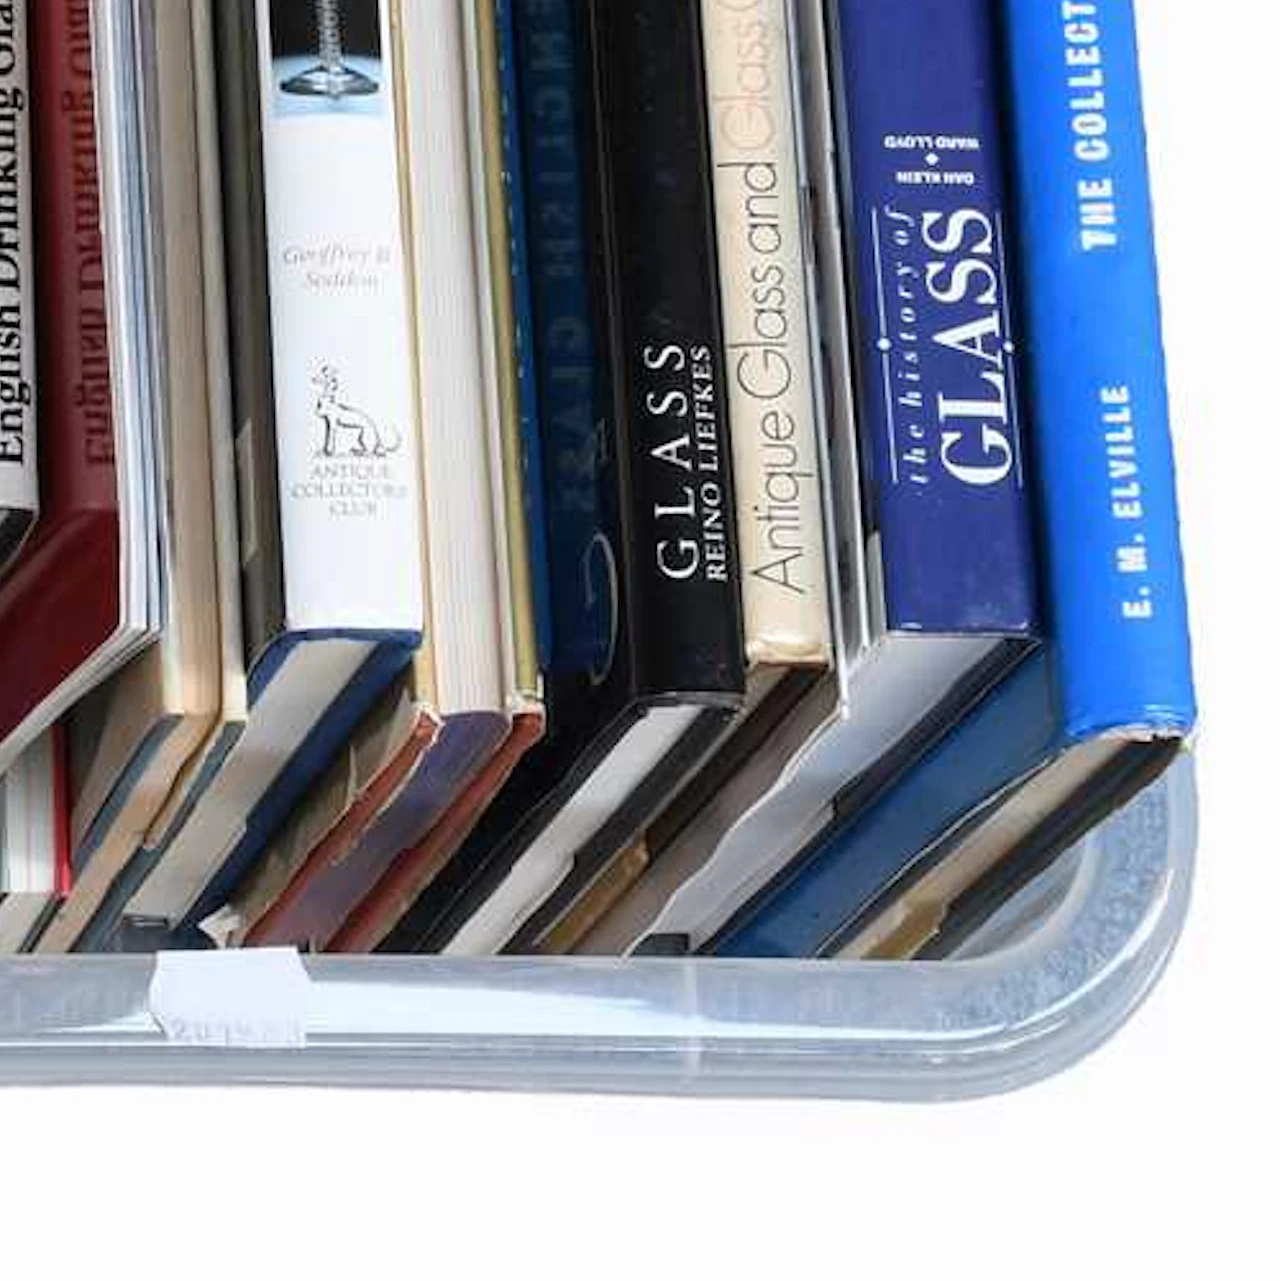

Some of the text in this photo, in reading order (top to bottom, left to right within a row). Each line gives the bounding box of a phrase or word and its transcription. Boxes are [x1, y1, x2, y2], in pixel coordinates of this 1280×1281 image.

[714, 22, 775, 152] Glass
[884, 135, 979, 149] WARD LLOYD
[717, 162, 783, 253] and
[896, 171, 974, 185] DAN KLEIN
[1075, 180, 1117, 251] THE
[730, 264, 792, 399] Glass
[884, 209, 928, 484] the history of
[922, 207, 1013, 485] GLASS
[645, 344, 699, 580] GLASS
[691, 346, 727, 581] REINO LIEFKES
[750, 408, 813, 594] Antique
[1100, 385, 1152, 619] E. M. ELVILLE
